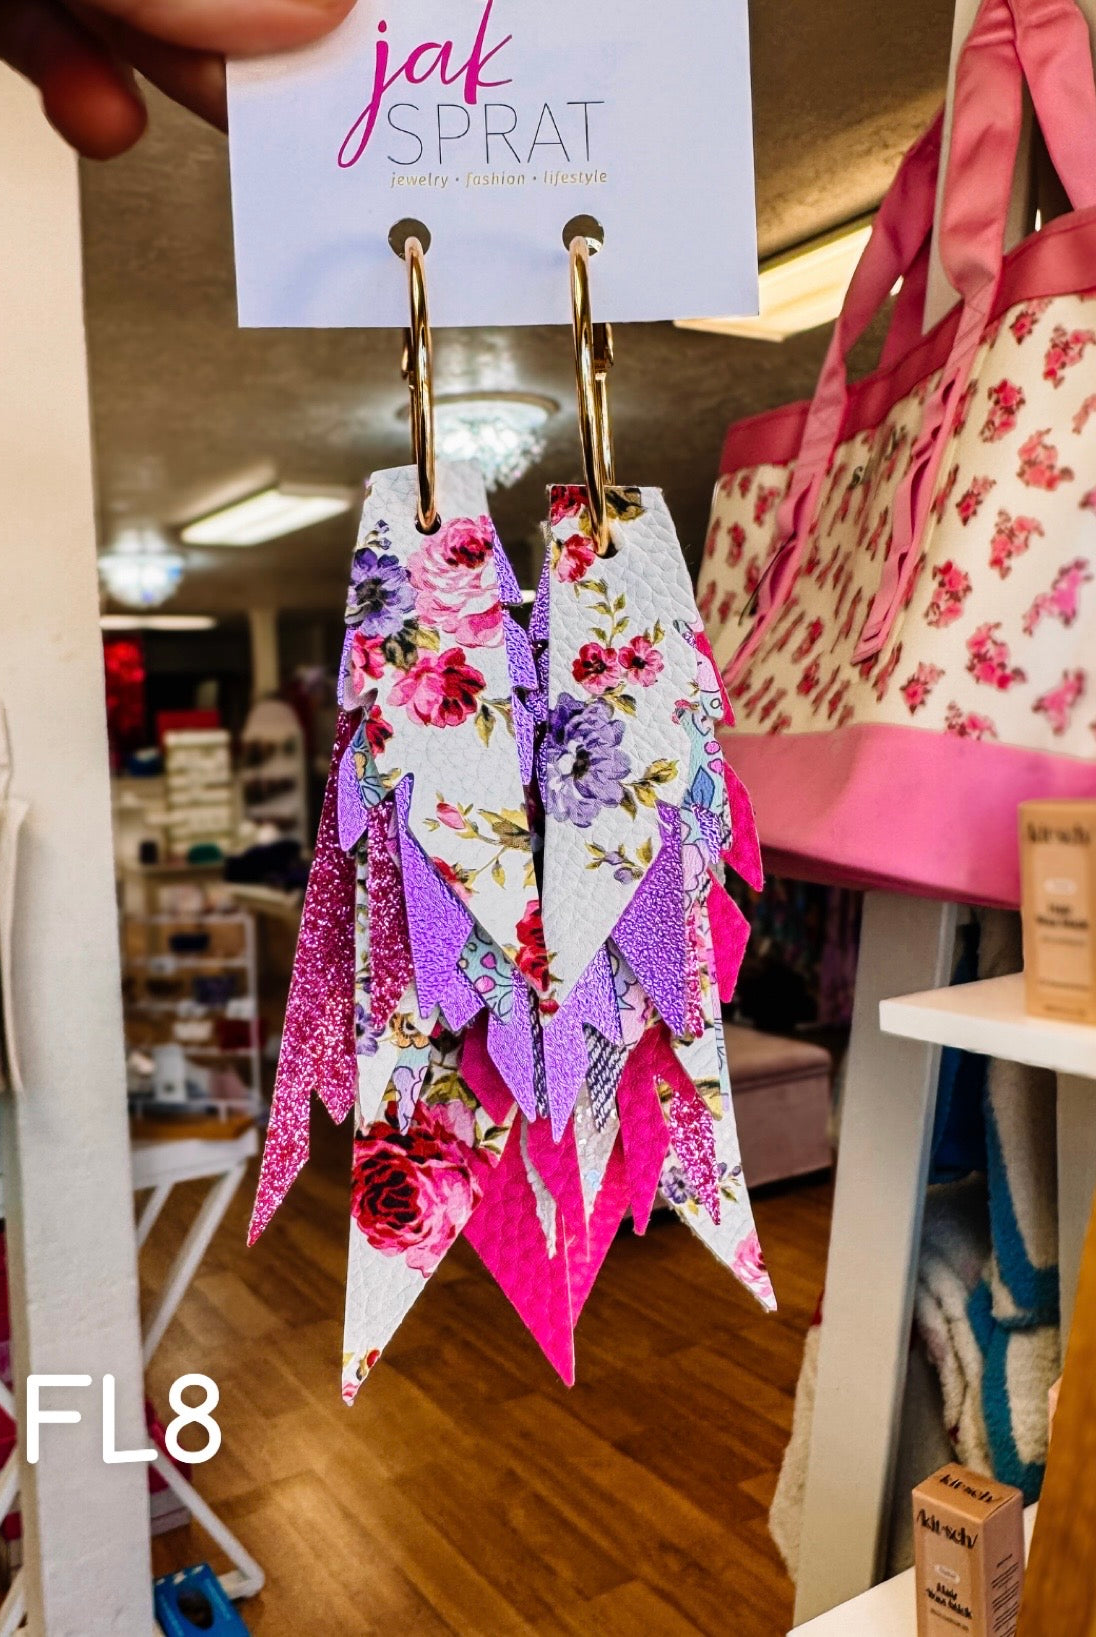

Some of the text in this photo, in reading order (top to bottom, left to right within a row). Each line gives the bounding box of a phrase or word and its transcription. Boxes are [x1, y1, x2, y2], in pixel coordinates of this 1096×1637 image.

[337, 0, 513, 168] jak
[387, 100, 605, 166] SPRAT
[390, 169, 608, 189] jewelry fashion lifestyle
